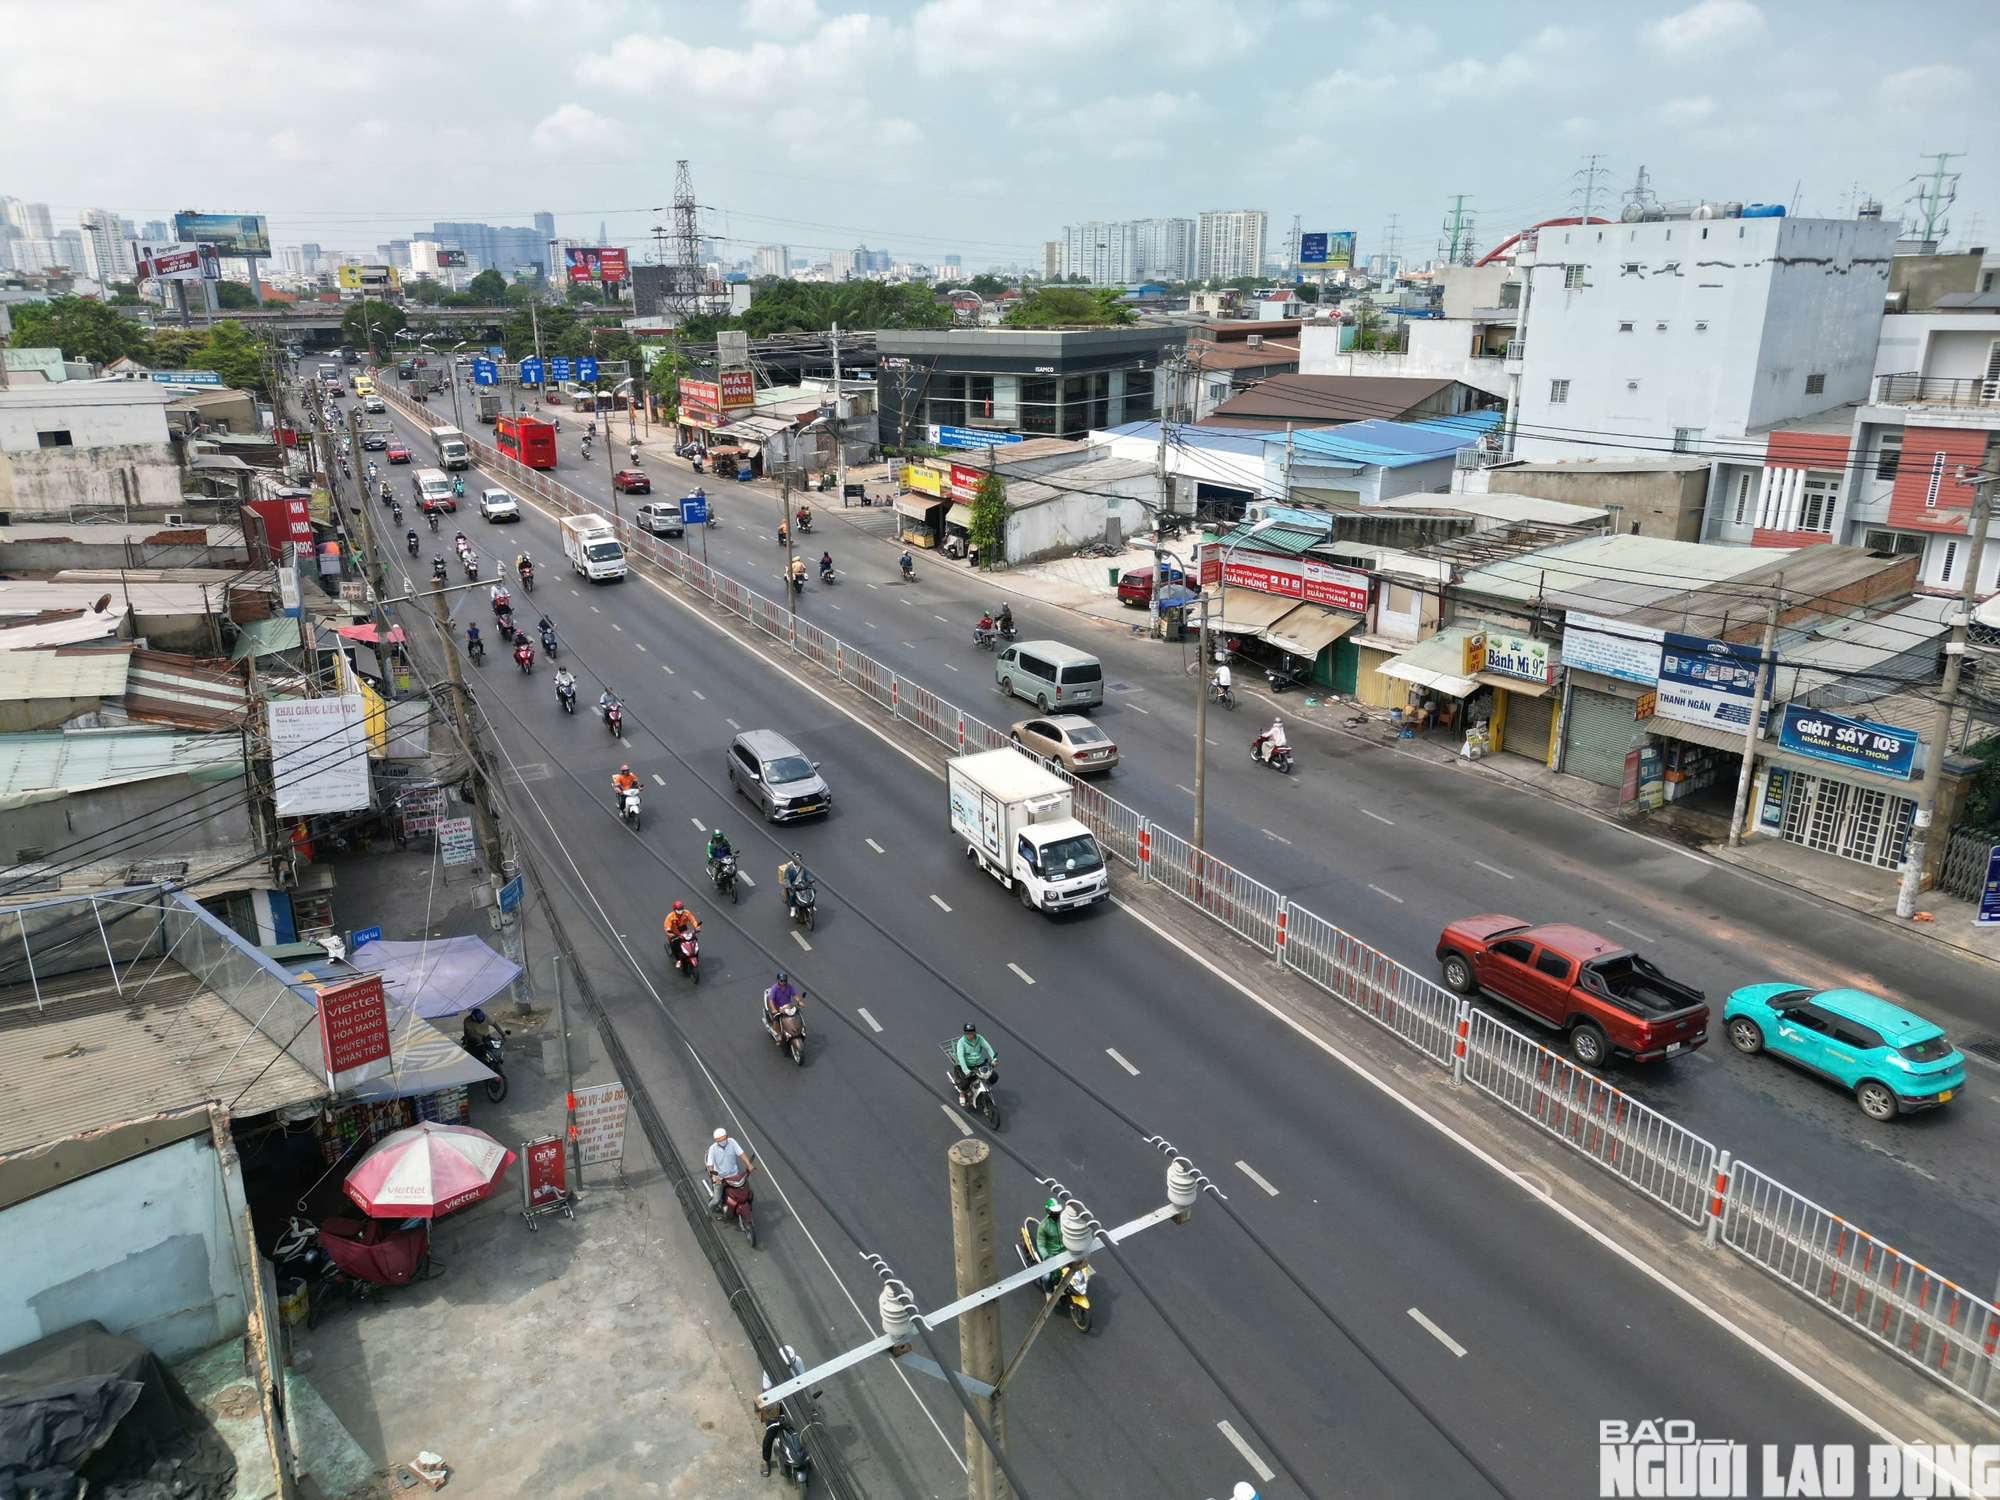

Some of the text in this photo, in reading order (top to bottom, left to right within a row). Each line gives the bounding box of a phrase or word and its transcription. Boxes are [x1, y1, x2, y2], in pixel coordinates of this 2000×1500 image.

[156, 244, 180, 254] Energizer
[724, 386, 752, 396] KÍNH
[290, 502, 304, 514] NHA
[291, 522, 310, 534] KHOA
[294, 541, 312, 554] NGỌC
[1245, 577, 1268, 588] HÙNG
[1307, 589, 1324, 598] XUÂN
[1470, 661, 1479, 672] 97
[1488, 649, 1513, 671] Bánh
[1517, 656, 1529, 674] Mì
[1532, 658, 1544, 677] 97
[1660, 693, 1711, 712] THANH NGÂN
[275, 707, 294, 716] KHAI
[296, 703, 320, 715] GIẢNG
[1796, 719, 1900, 753] GIẶT SẤY 103
[1801, 735, 1830, 747] NHANH
[1836, 743, 1859, 754] SẠCH
[1865, 749, 1889, 761] THƠM
[357, 932, 369, 942] HẺM
[325, 998, 336, 1006] CH
[338, 991, 359, 1002] GIAO
[328, 994, 381, 1017] viettel
[332, 1017, 352, 1030] THU
[535, 1148, 556, 1162] nine
[388, 1186, 426, 1194] viettel
[350, 1187, 367, 1209] viettel
[444, 1190, 480, 1210] viettel
